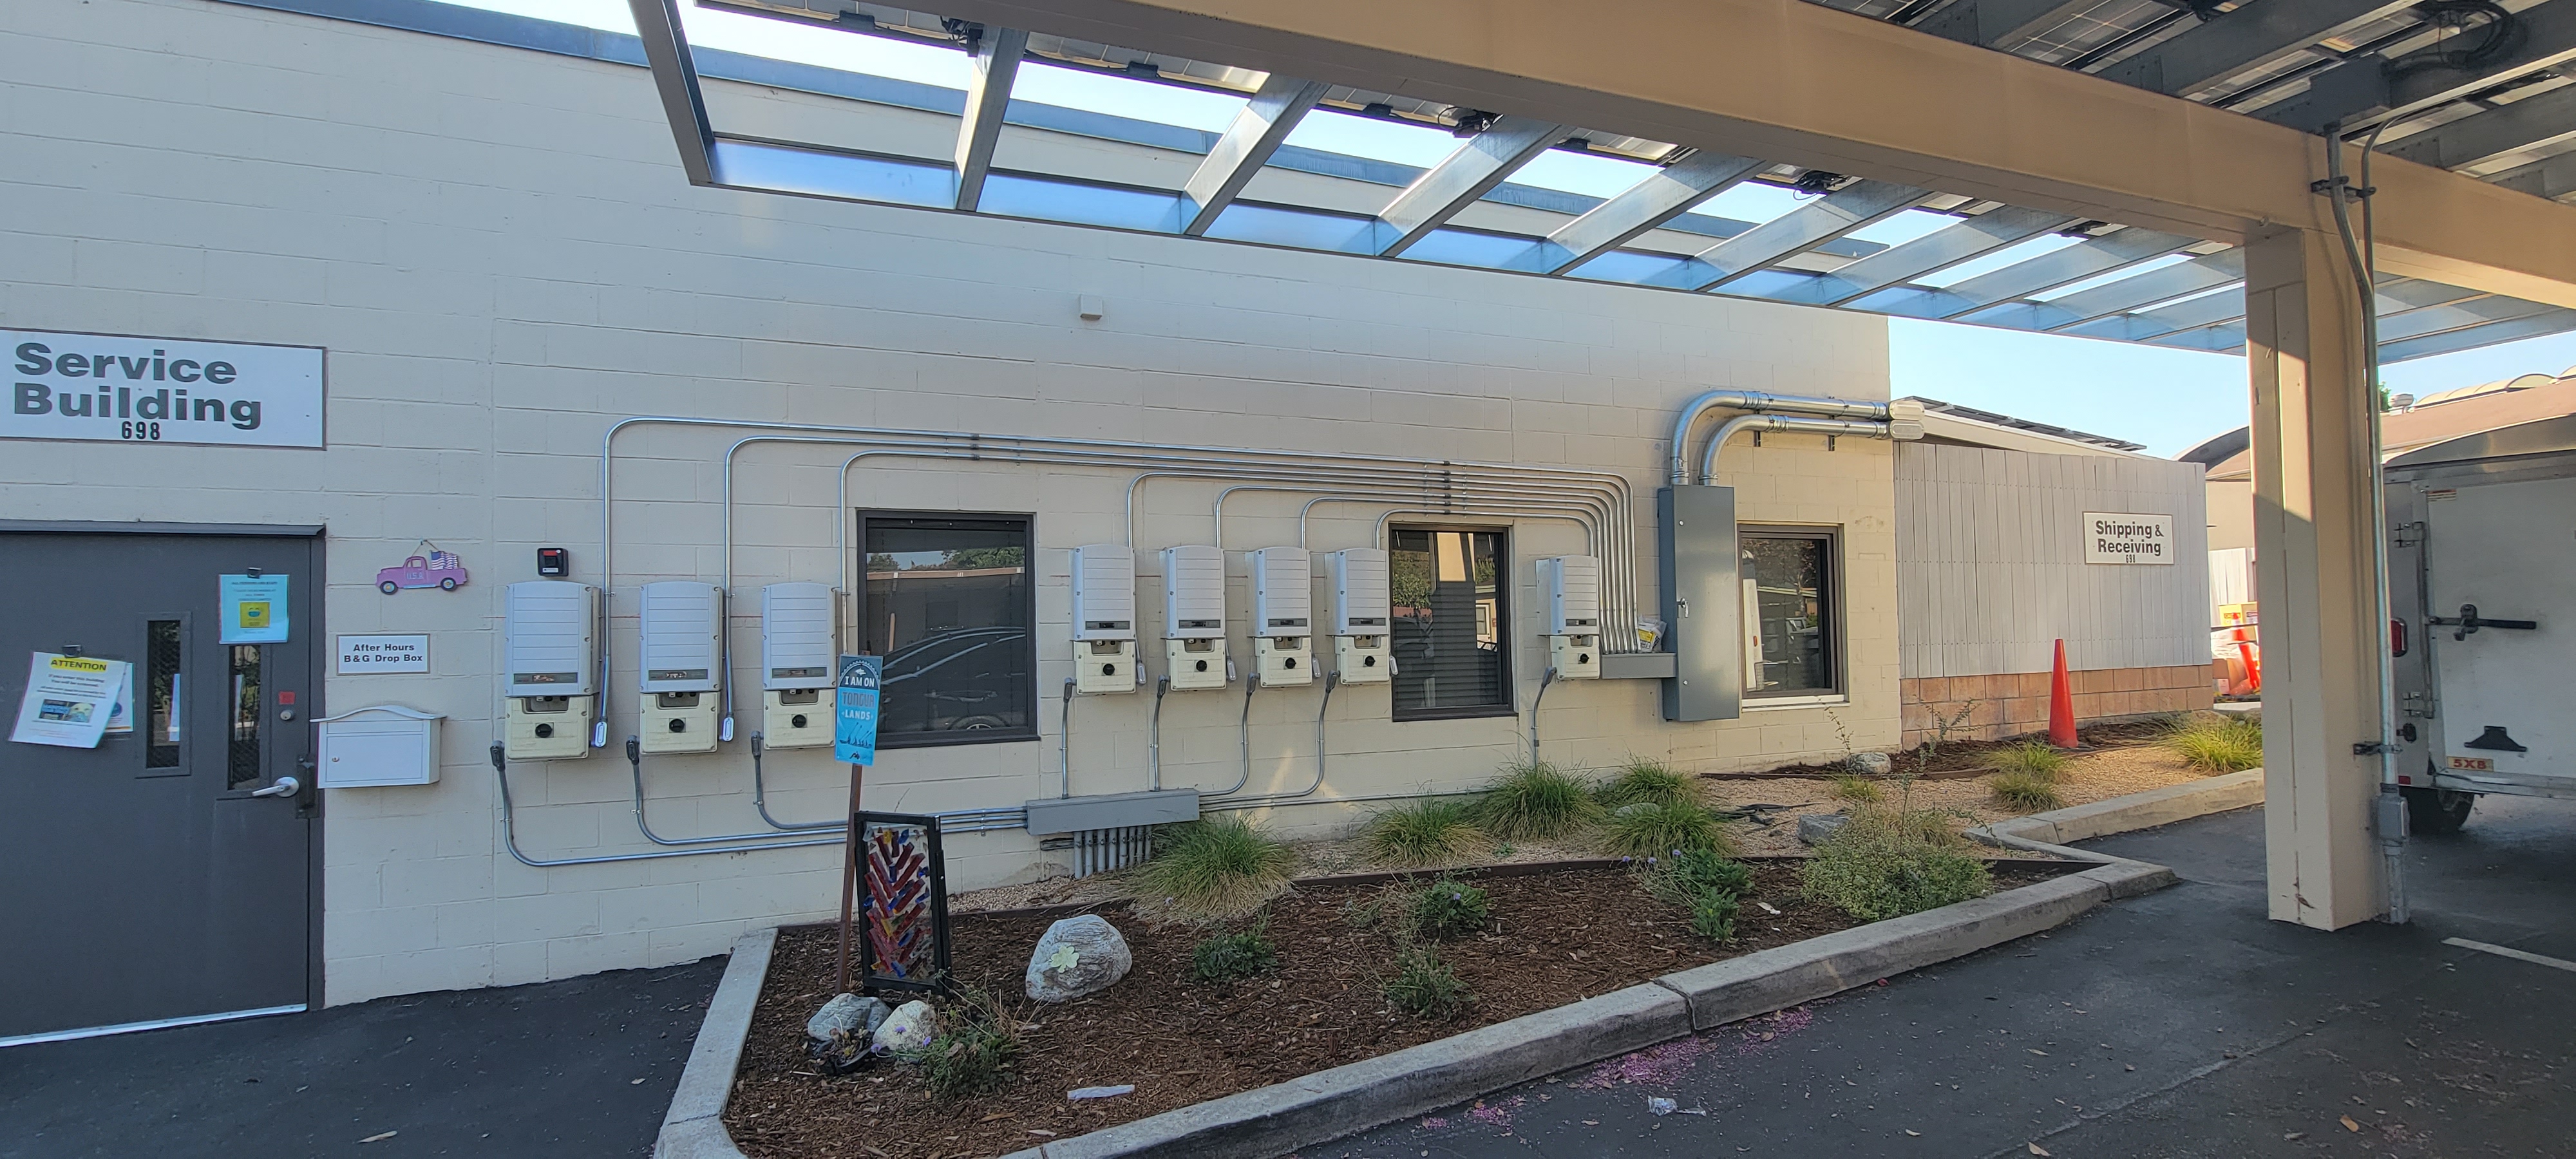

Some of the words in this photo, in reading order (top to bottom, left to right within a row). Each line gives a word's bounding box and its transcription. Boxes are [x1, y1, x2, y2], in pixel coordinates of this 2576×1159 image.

[14, 343, 237, 384] Service
[14, 382, 261, 430] Building
[121, 421, 161, 440] 698
[2096, 520, 2152, 539] Shipping
[2155, 524, 2164, 537] &
[2098, 538, 2161, 556] Receiving
[2126, 554, 2136, 563] 698
[51, 659, 107, 671] ATTENTION
[375, 655, 400, 663] Drop
[845, 676, 849, 685] I
[851, 677, 862, 686] AM
[864, 678, 875, 688] ON
[844, 710, 871, 721] LANDS
[2454, 759, 2486, 769] 5X8
